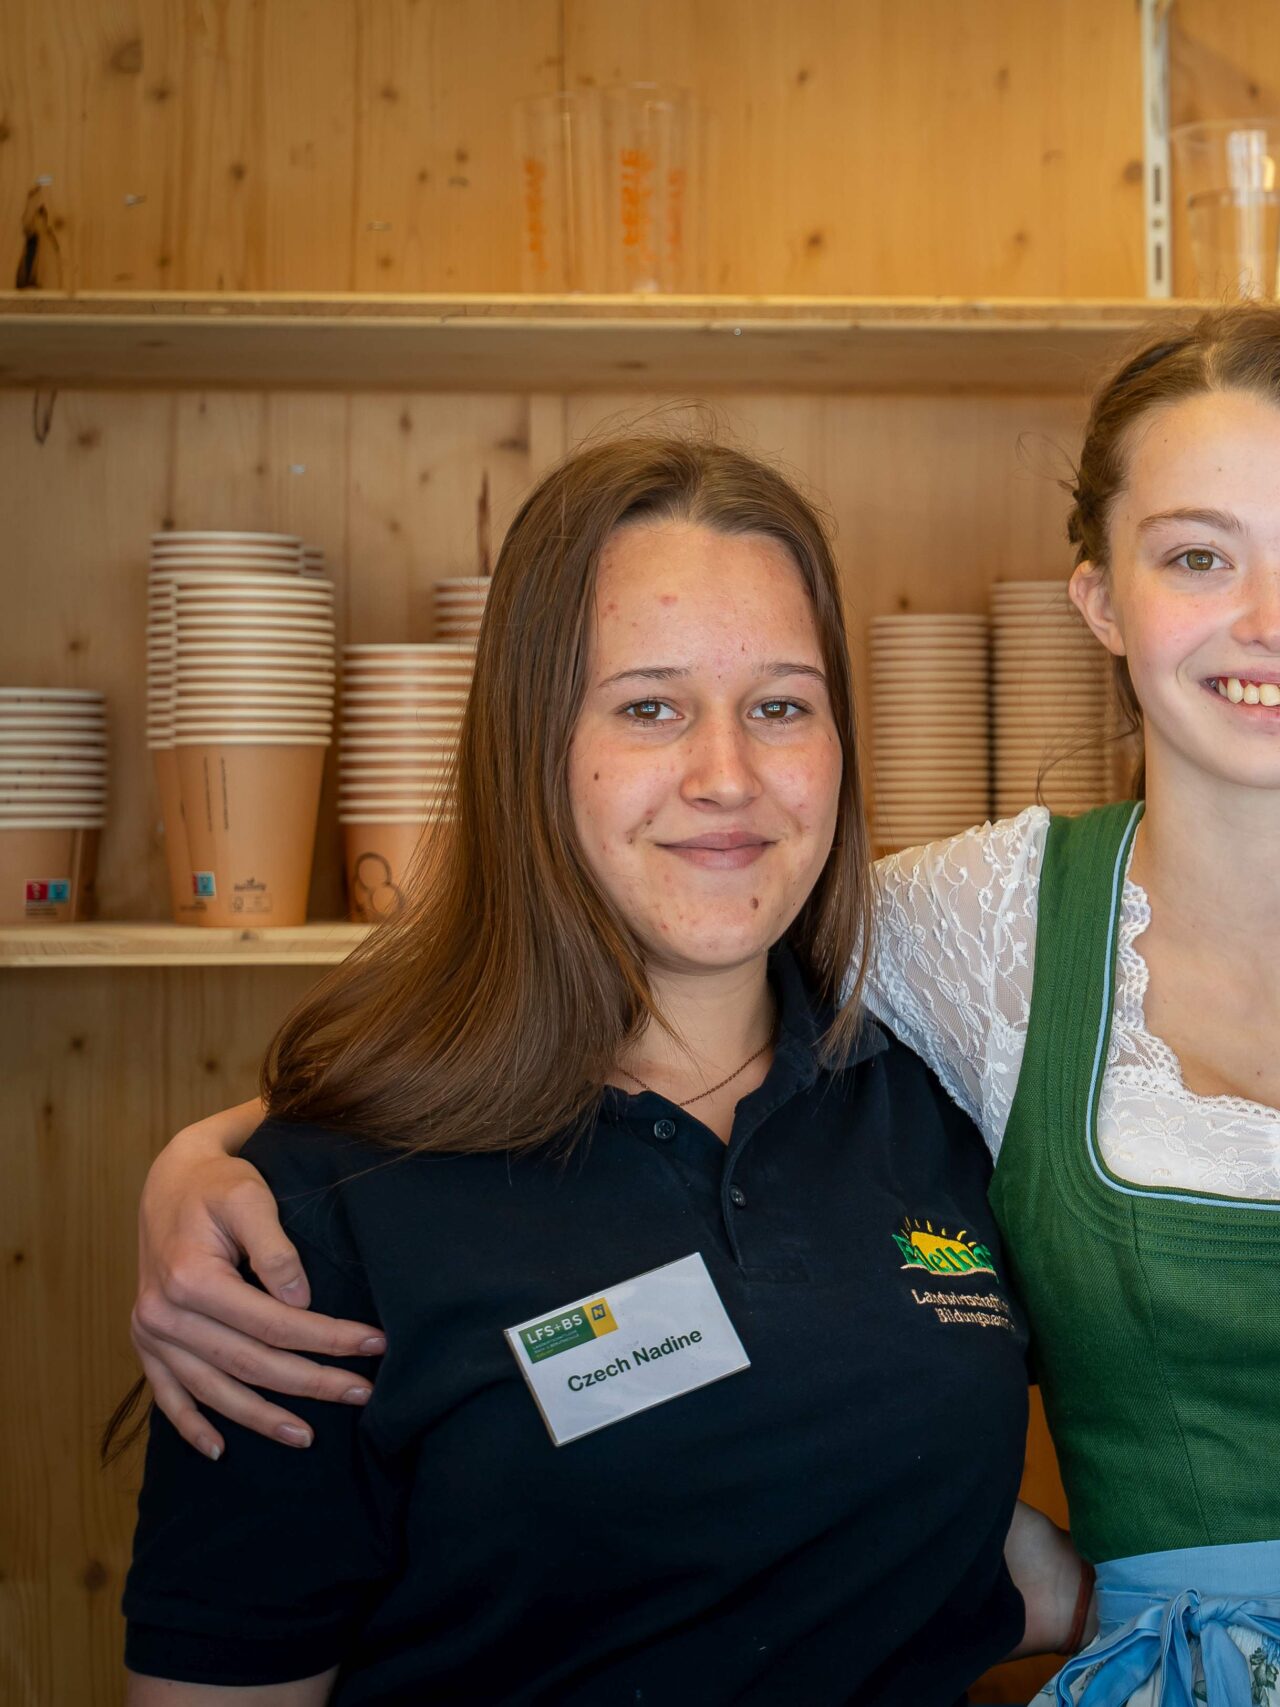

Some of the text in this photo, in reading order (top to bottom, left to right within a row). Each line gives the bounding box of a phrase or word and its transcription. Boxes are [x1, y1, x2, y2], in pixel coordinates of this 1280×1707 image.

[526, 1313, 584, 1345] LFS+BS
[567, 1330, 704, 1393] Czech Nadine
